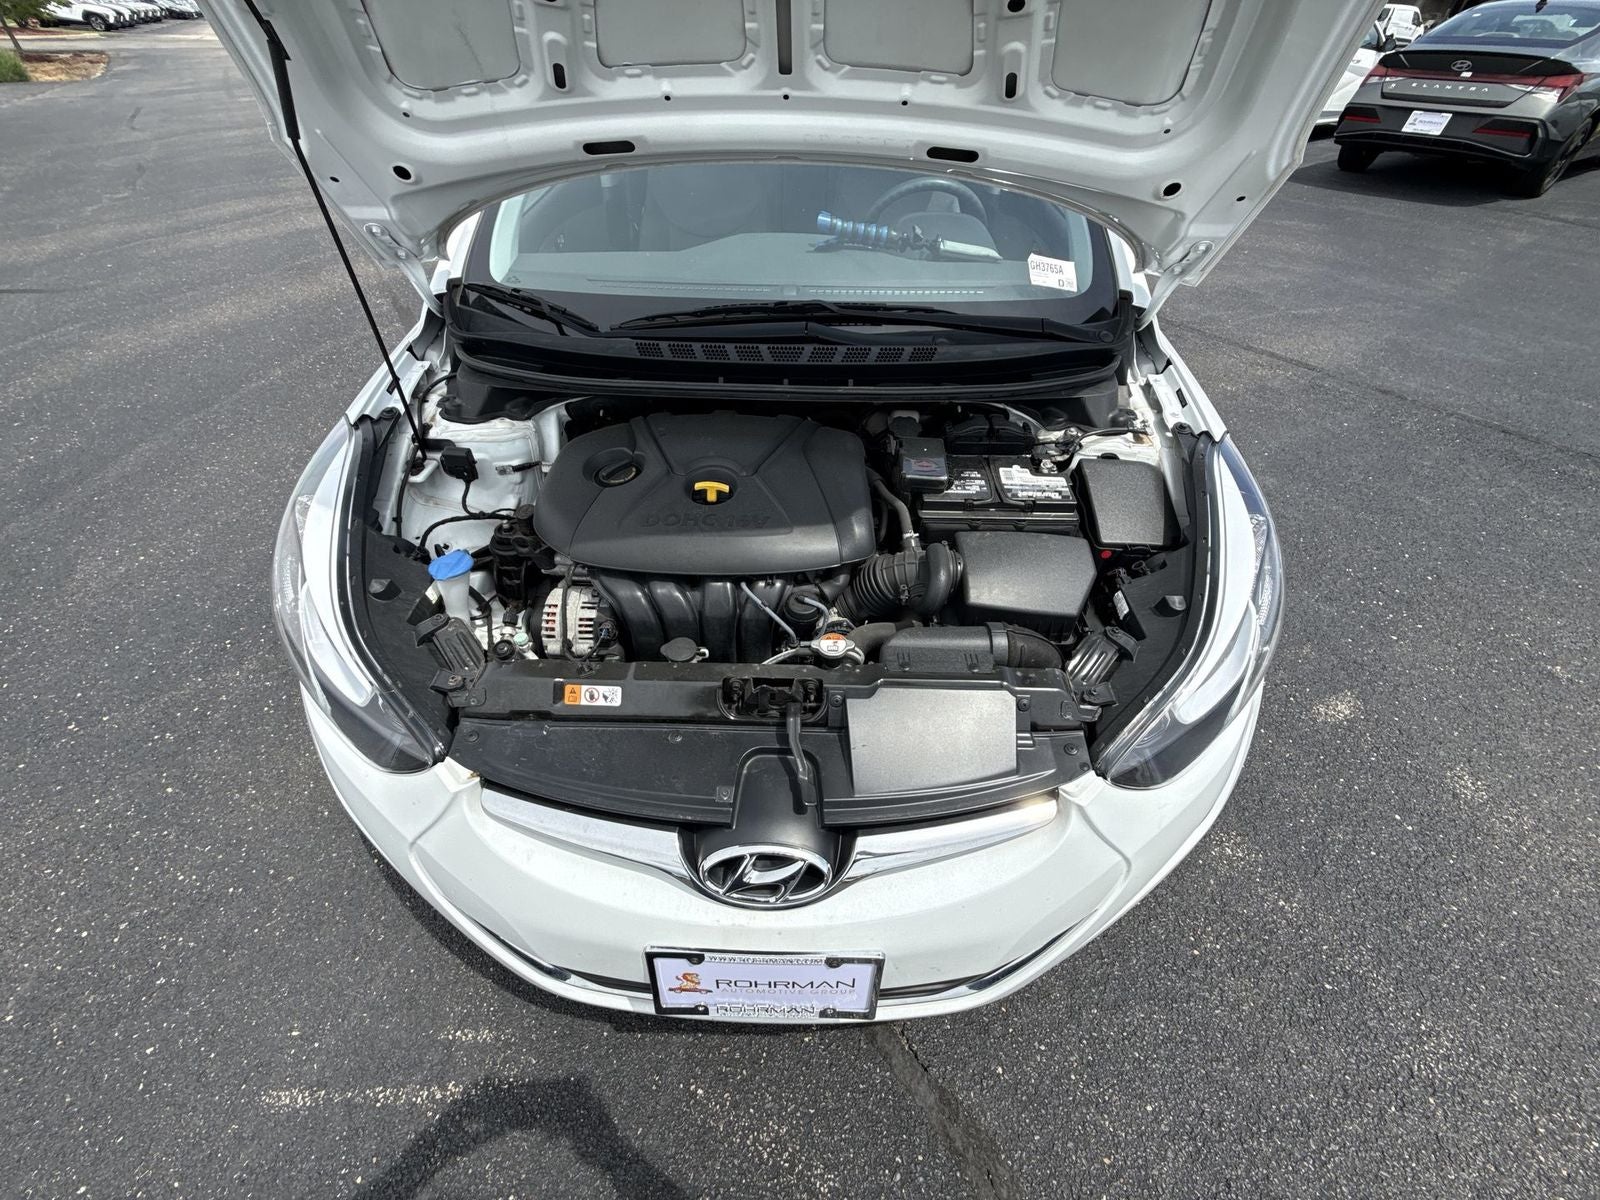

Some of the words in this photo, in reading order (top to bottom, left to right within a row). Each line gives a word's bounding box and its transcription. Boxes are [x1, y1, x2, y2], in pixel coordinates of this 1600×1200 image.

[1411, 82, 1489, 92] ELANTRA
[1030, 260, 1064, 275] GH3765A
[640, 512, 718, 528] DOHC
[715, 977, 856, 989] ROHRMAN
[716, 1004, 815, 1014] ROHRMAN
